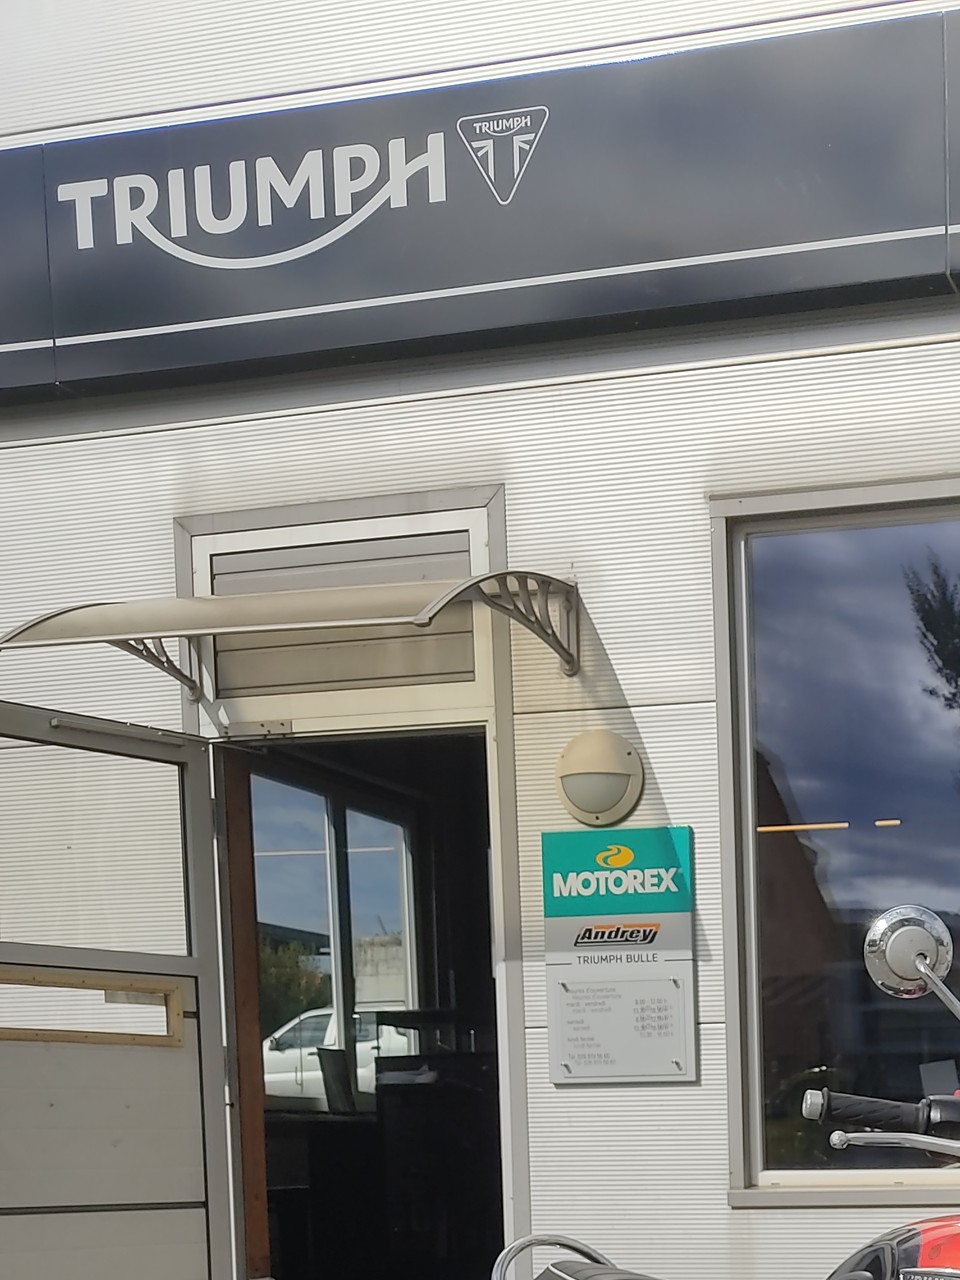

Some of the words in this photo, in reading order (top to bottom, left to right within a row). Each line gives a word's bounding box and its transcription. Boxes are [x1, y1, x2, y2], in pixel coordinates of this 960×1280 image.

[473, 114, 531, 136] TRIUMPH
[57, 132, 446, 269] TRIUMPH
[552, 867, 679, 897] MOTOREX
[578, 925, 654, 944] Andrey
[577, 955, 623, 965] TRIUMPH
[626, 953, 658, 963] BULLE
